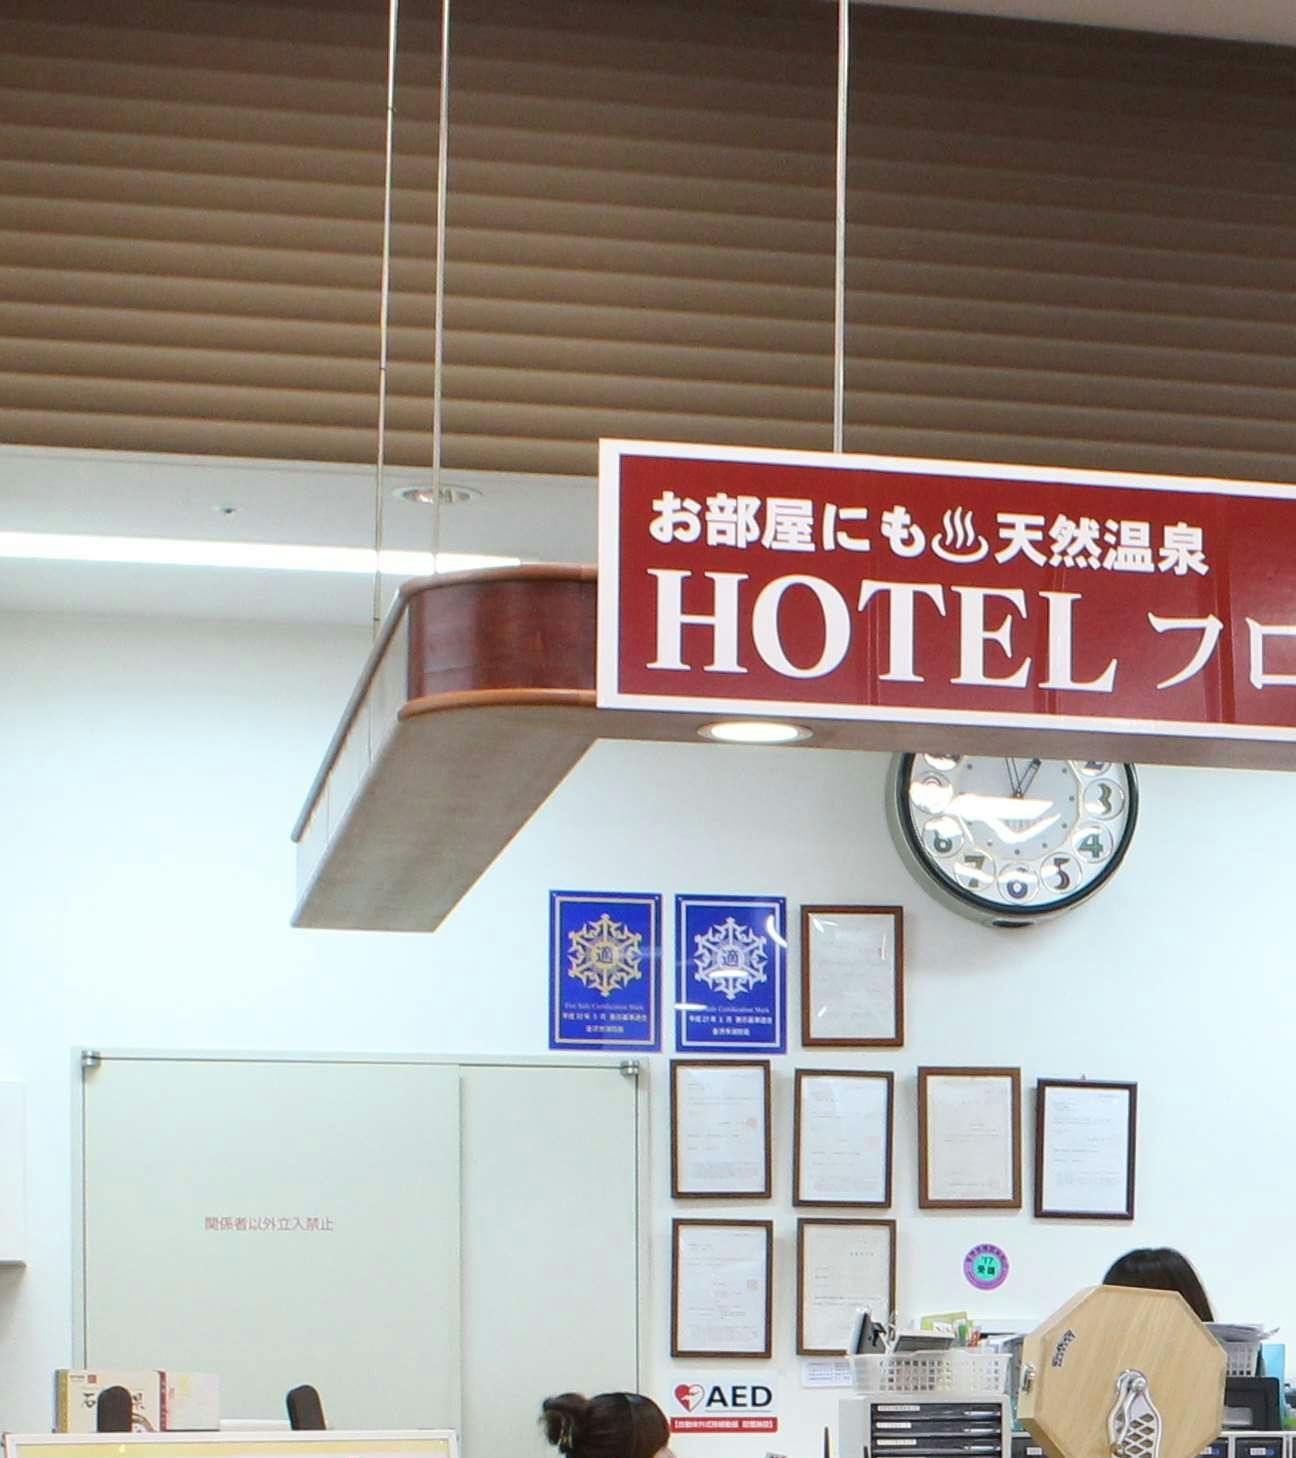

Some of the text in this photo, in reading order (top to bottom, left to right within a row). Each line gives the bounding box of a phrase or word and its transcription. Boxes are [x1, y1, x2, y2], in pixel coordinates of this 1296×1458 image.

[646, 489, 1210, 578] お部屋にも 天然温泉
[645, 566, 1119, 694] HOTEL
[204, 1216, 334, 1231] 関係者以外立入禁止
[706, 1386, 773, 1407] AED
